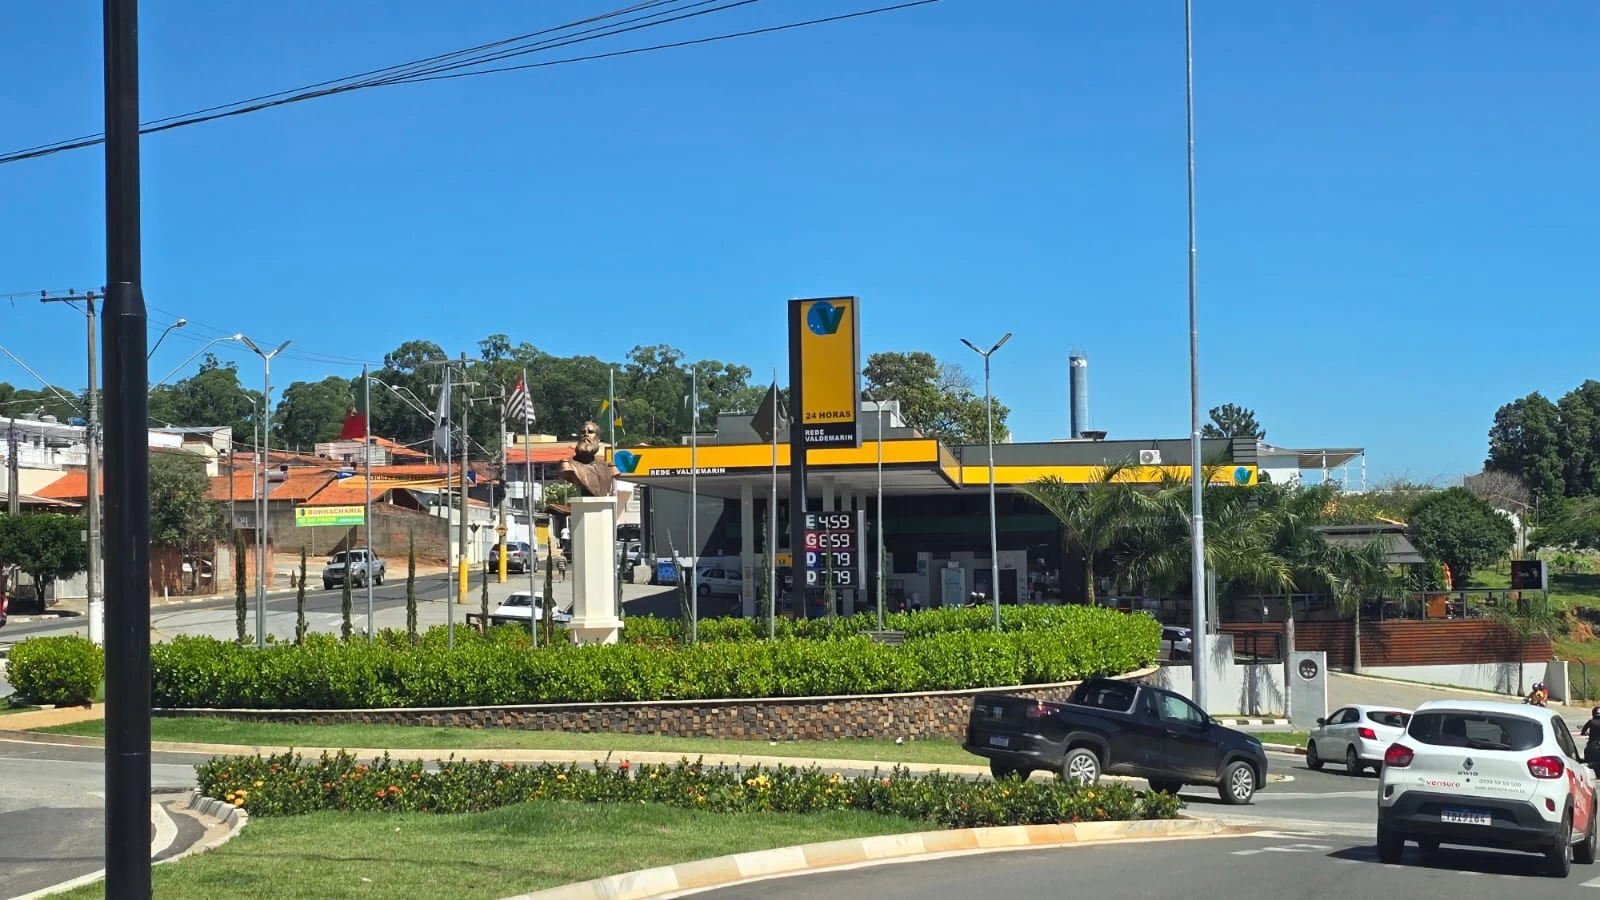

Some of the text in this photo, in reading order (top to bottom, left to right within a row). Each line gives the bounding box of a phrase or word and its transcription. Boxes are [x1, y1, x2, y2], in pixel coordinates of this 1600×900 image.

[806, 410, 851, 420] 24 HORAS
[307, 507, 362, 515] BORRACHARIA
[806, 514, 816, 526] E
[806, 534, 817, 546] G
[806, 552, 817, 566] D
[806, 570, 817, 583] D
[1426, 779, 1461, 788] verisure
